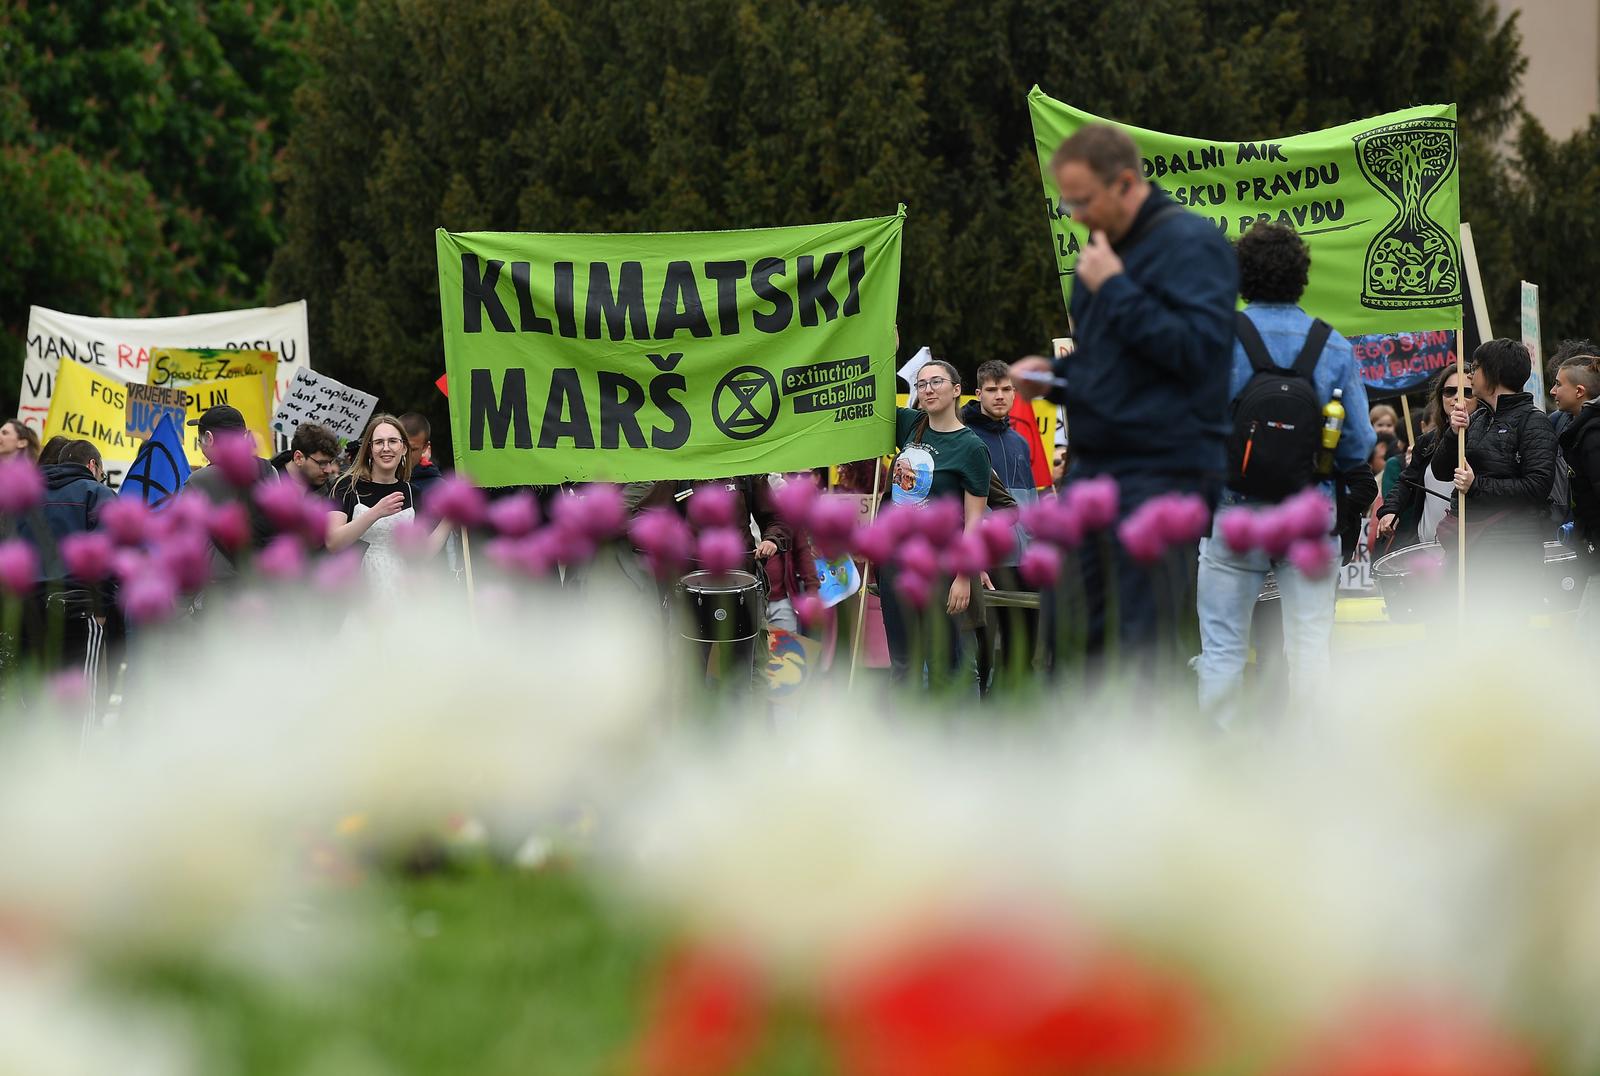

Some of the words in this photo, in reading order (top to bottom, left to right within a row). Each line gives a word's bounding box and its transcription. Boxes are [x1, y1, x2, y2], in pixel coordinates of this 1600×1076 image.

[1141, 146, 1225, 178] OBALNI
[1236, 162, 1340, 201] PRAVDU
[1057, 232, 1081, 257] ZA
[461, 246, 866, 341] KLIMATSKI
[27, 335, 107, 367] MANJE
[117, 344, 150, 369] RA
[786, 363, 862, 388] extinction
[90, 380, 125, 410] FOS
[127, 382, 172, 405] VRIJEME
[174, 390, 187, 407] JE
[320, 387, 368, 410] capitalists
[469, 353, 692, 451] MARŠ
[812, 382, 873, 407] rebellion
[277, 412, 289, 421] on
[286, 402, 302, 412] are
[304, 411, 320, 421] no
[322, 418, 355, 434] profits
[339, 405, 361, 422] There
[834, 404, 874, 423] ZAGREB
